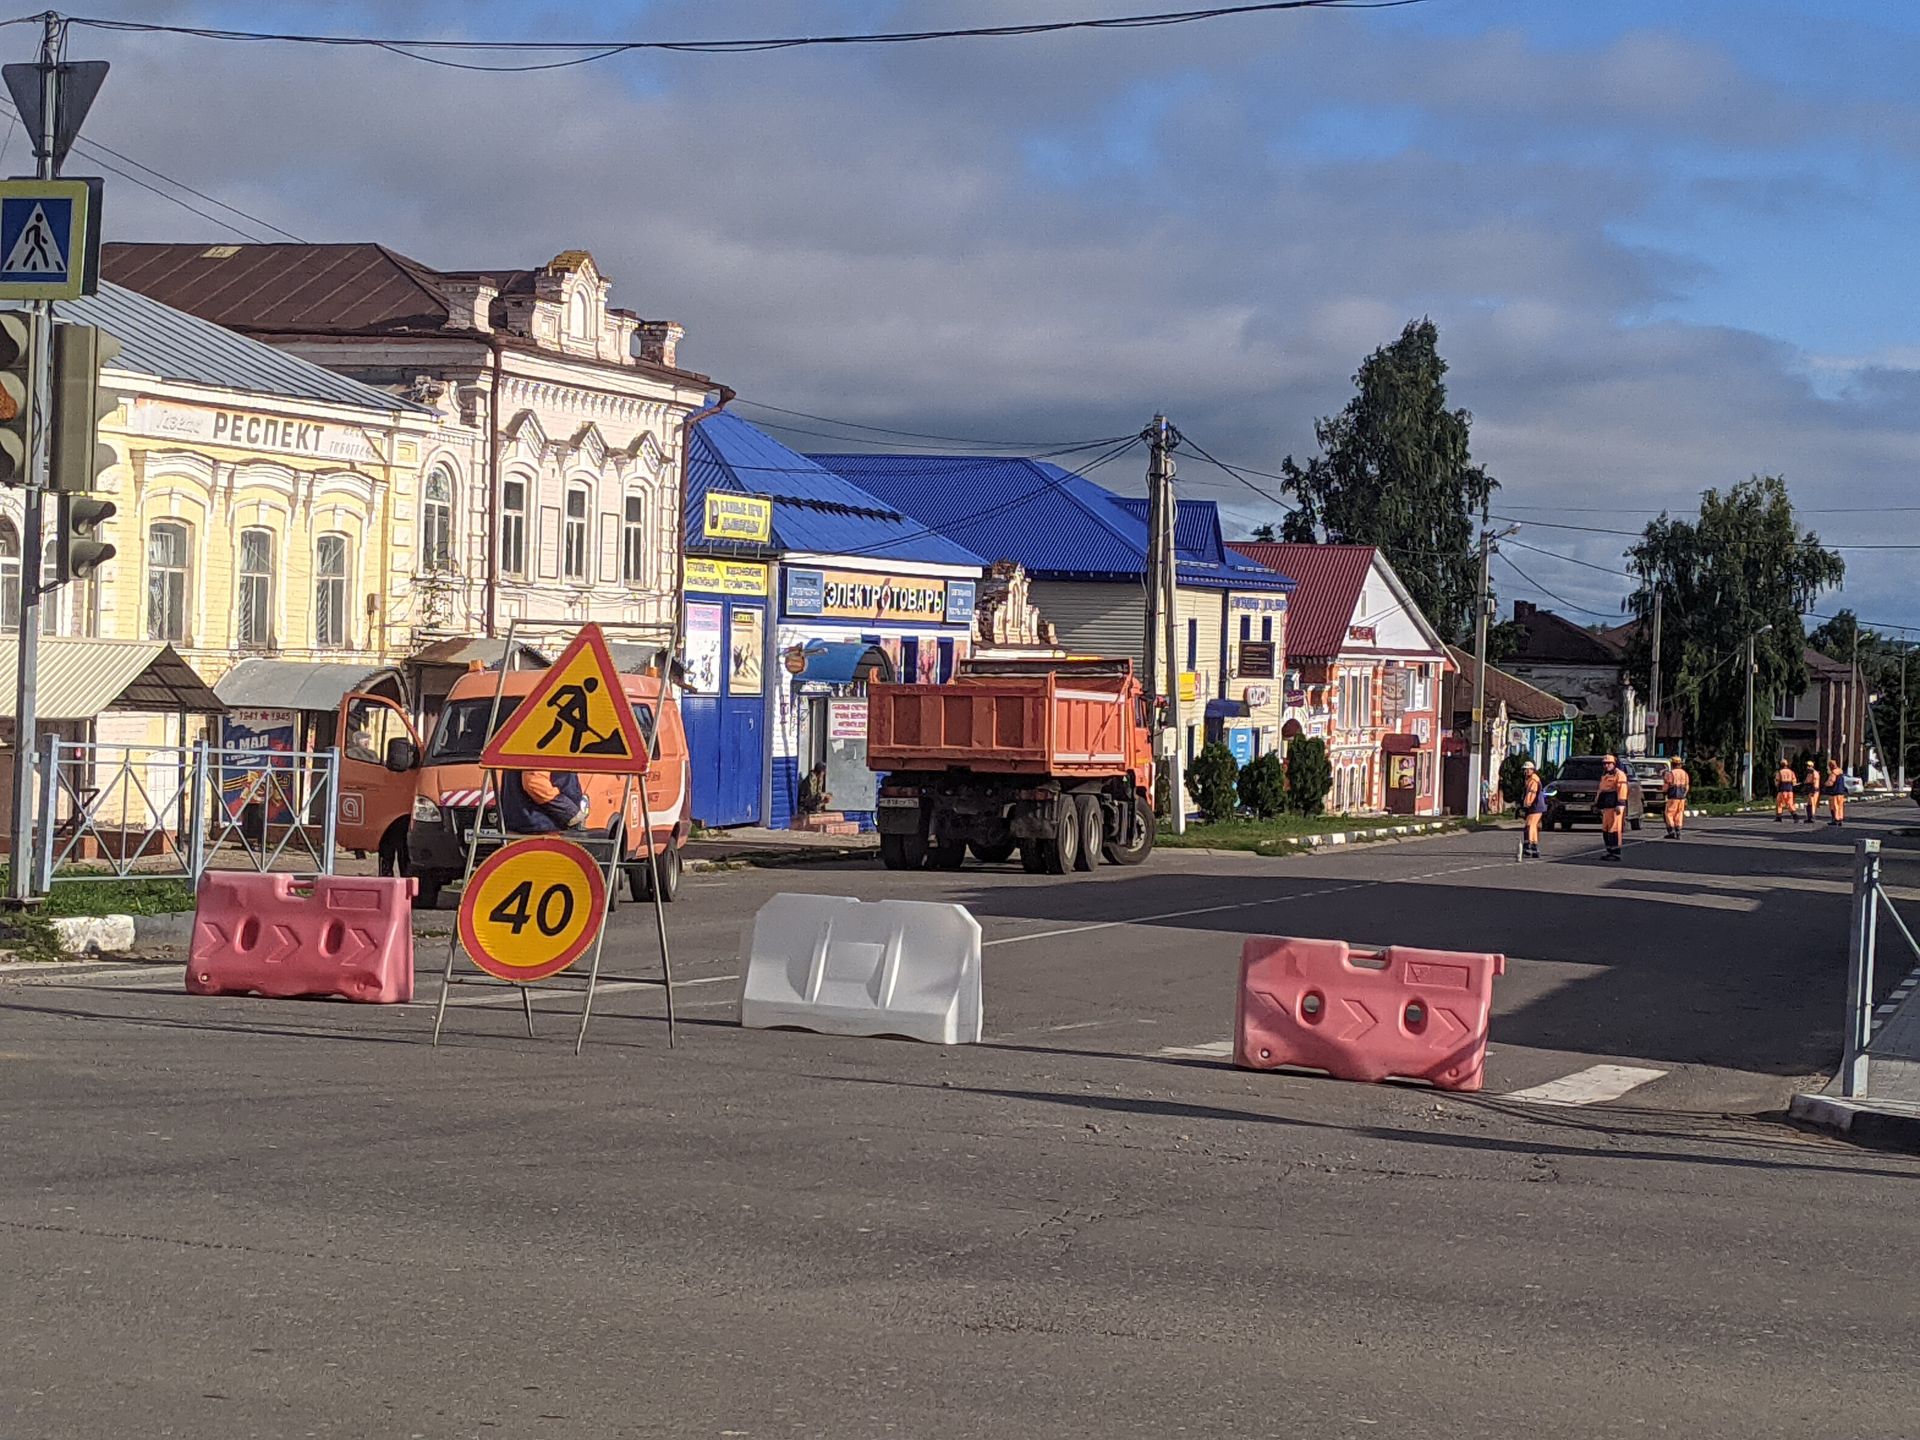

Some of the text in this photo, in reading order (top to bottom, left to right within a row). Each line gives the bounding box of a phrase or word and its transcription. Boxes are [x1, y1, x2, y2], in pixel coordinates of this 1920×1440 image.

[212, 411, 325, 452] РЕСПЕКТ
[825, 581, 946, 614] ЭЛЕКТРОТОВАРЫ
[239, 734, 269, 750] МАЯ
[489, 880, 574, 936] 40
